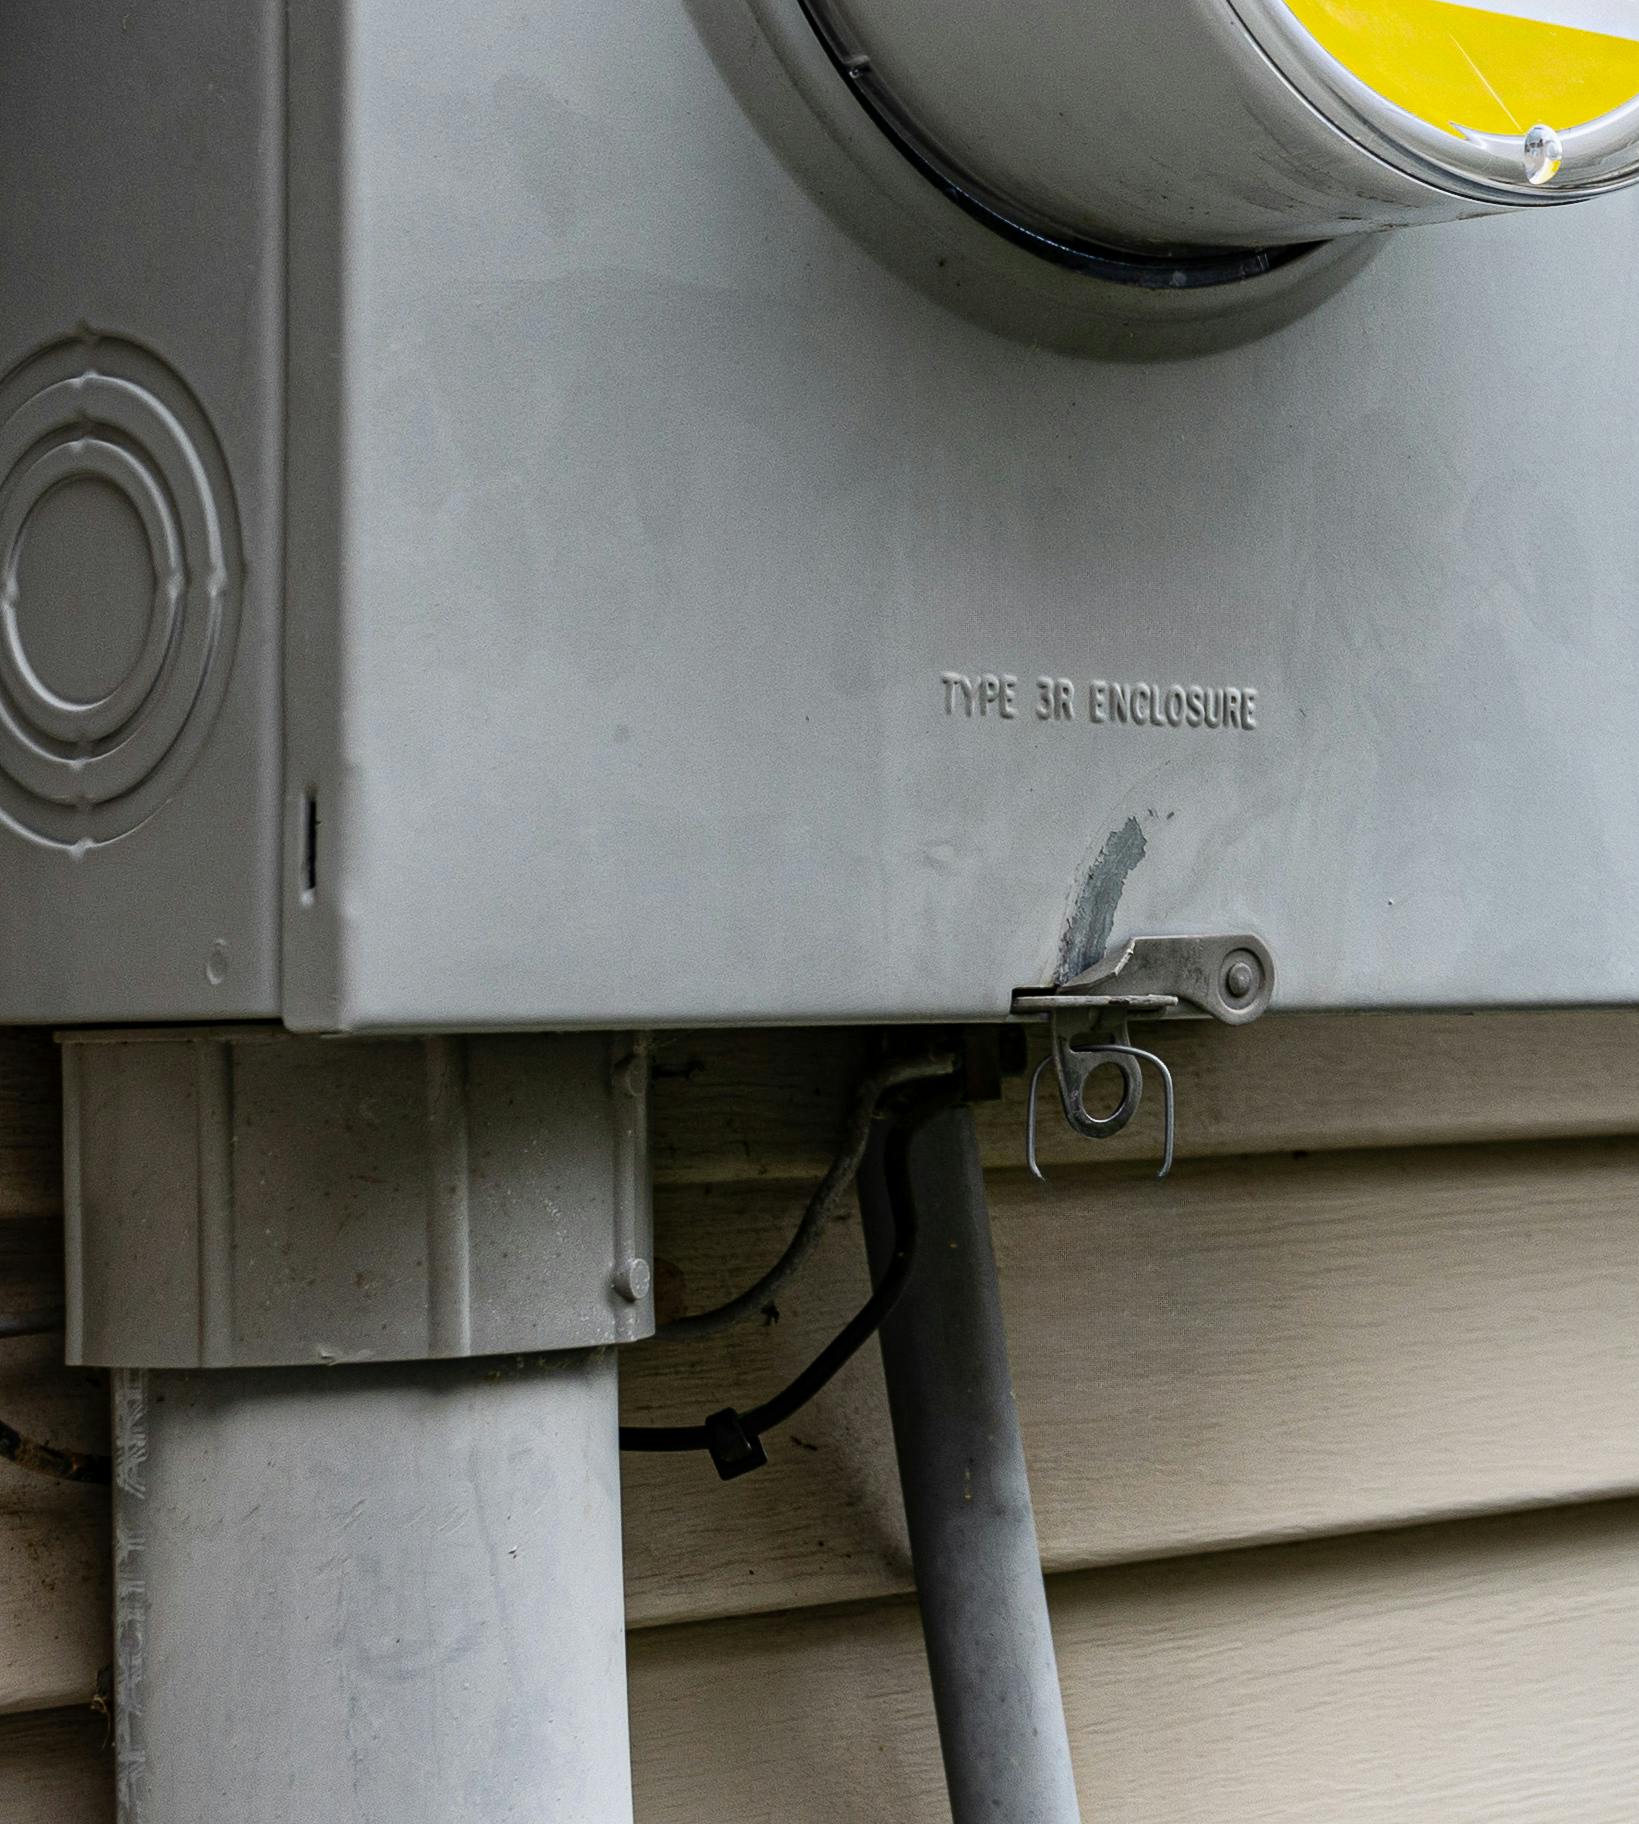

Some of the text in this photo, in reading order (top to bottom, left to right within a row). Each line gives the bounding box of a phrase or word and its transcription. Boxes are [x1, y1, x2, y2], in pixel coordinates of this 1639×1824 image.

[941, 672, 1257, 730] TYPE 3R ENCLOSURE
